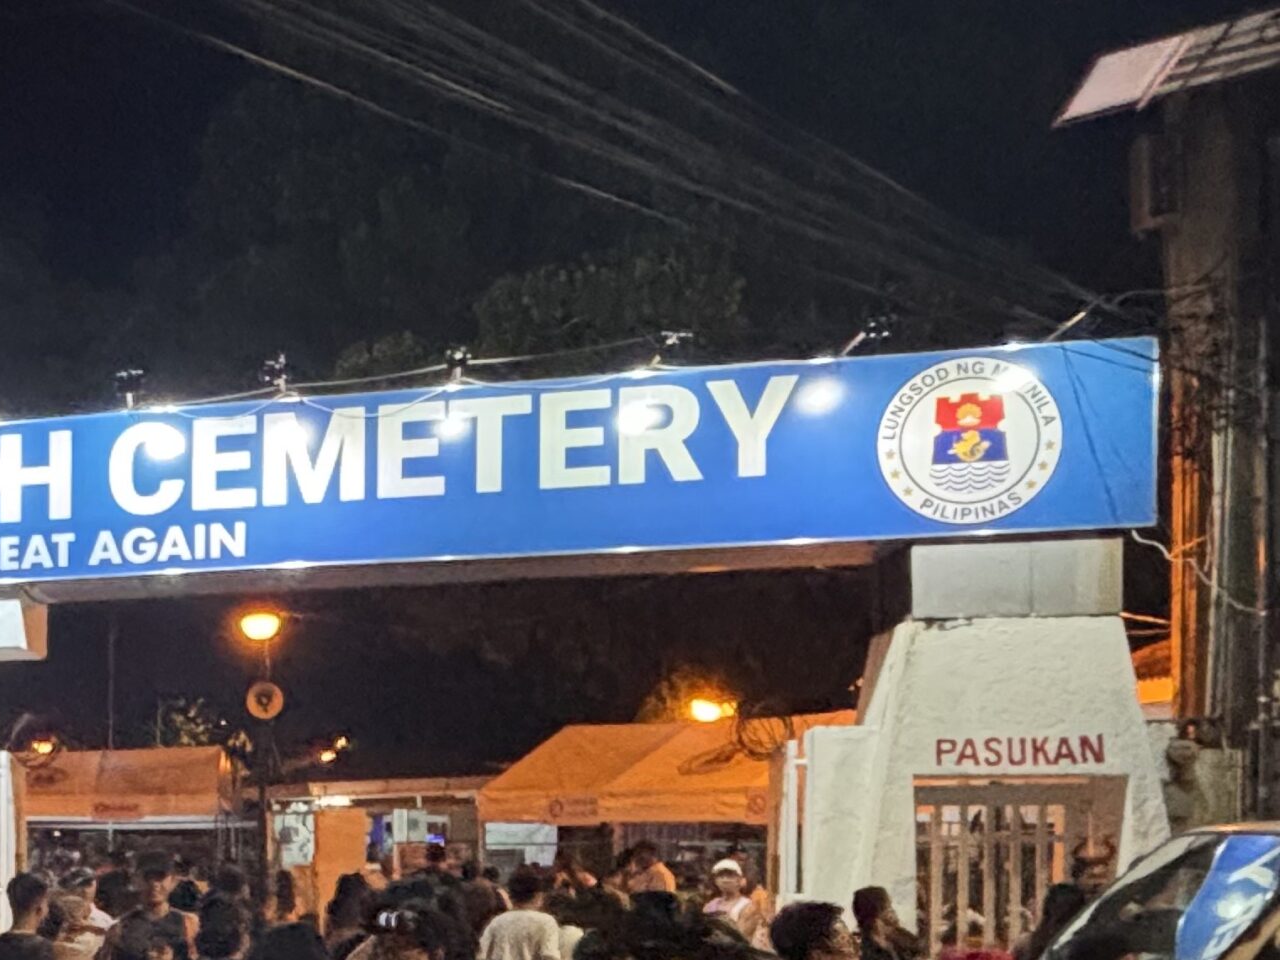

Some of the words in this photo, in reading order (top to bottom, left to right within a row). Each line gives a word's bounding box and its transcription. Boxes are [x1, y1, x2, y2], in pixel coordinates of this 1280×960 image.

[882, 367, 950, 440] LUNGSOD
[956, 361, 985, 376] NG
[990, 363, 1057, 427] MNILA
[108, 375, 799, 515] CEMETERY
[920, 491, 1023, 520] PILIPINAS
[88, 521, 248, 566] AGAIN
[936, 733, 1105, 766] PASUKAN
